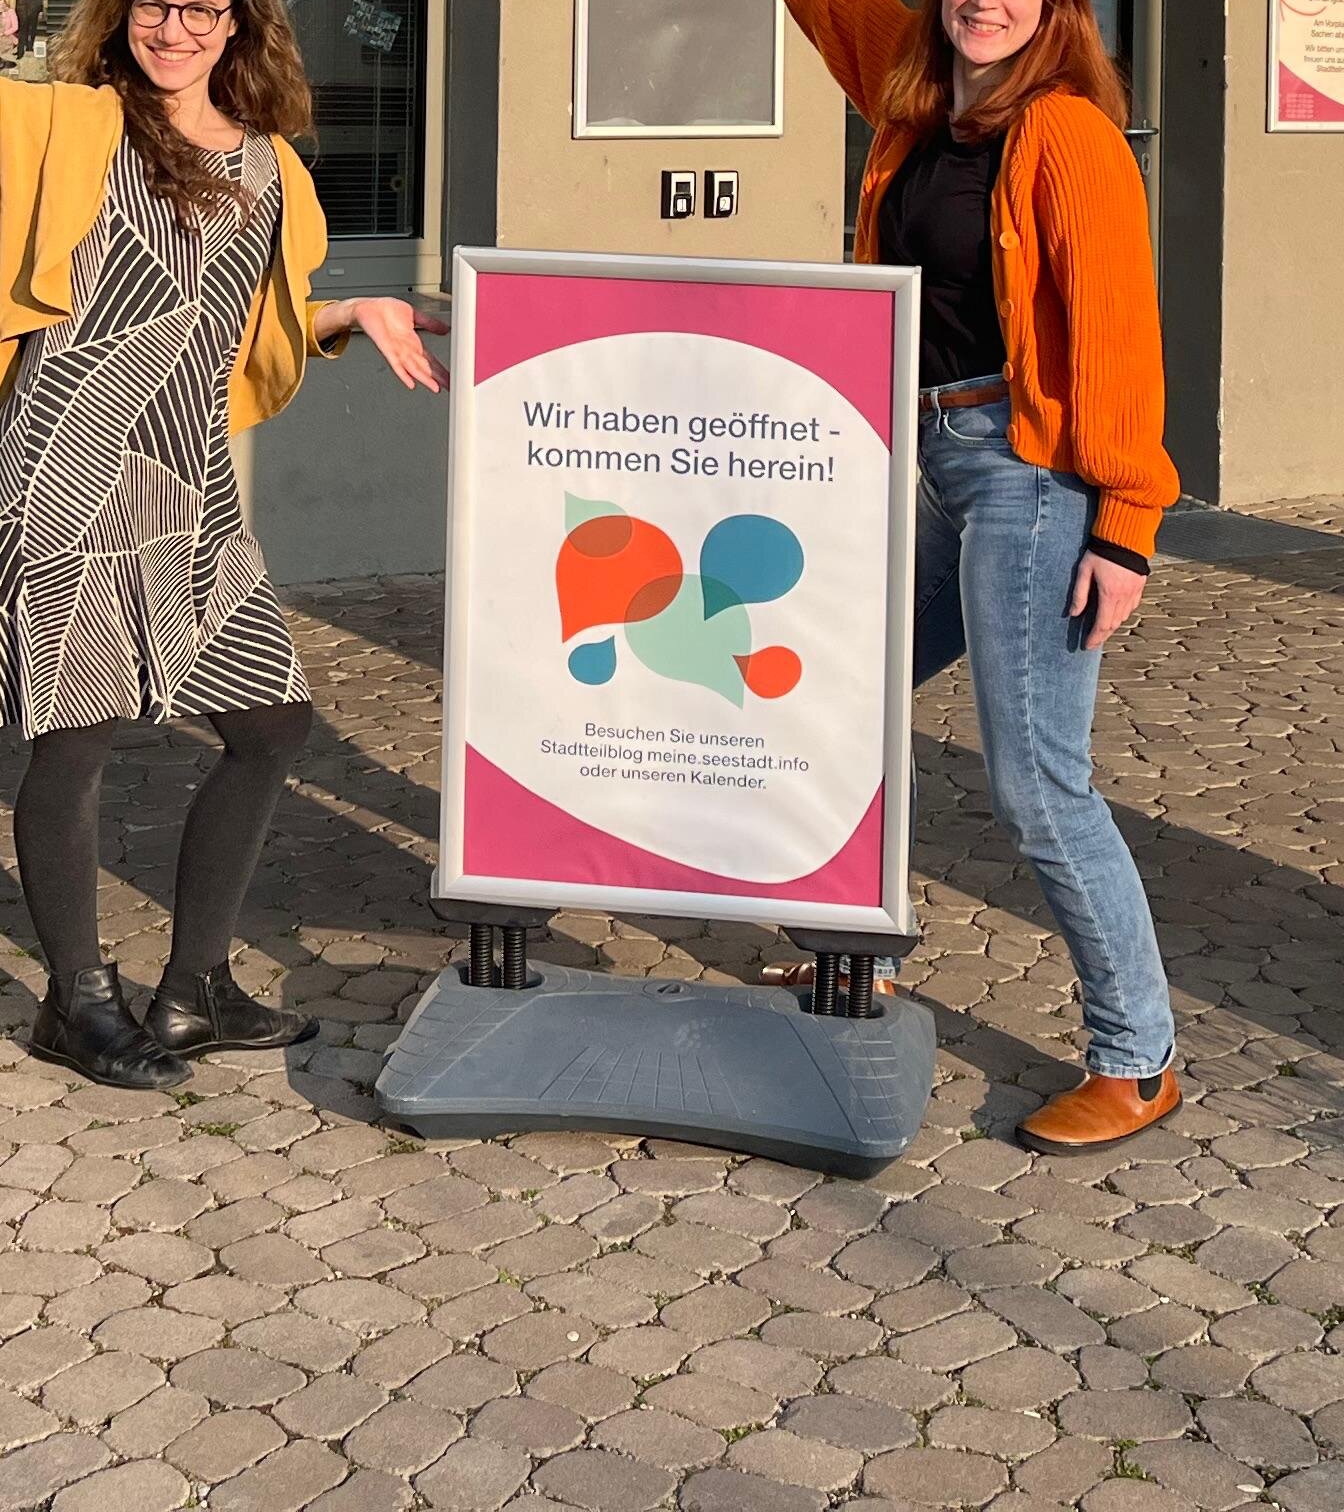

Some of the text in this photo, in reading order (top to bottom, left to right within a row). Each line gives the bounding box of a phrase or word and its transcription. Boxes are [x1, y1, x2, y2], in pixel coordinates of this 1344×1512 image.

[523, 401, 575, 429] Wir
[584, 405, 678, 435] haben
[688, 412, 820, 443] geöffnet
[528, 440, 834, 482] kommen Sie herein!
[585, 722, 765, 749] Besuchen Sie unseren
[541, 739, 809, 772] Stadtteilblog meine.seestadt.info
[580, 764, 767, 789] oder unseren Kalender.
